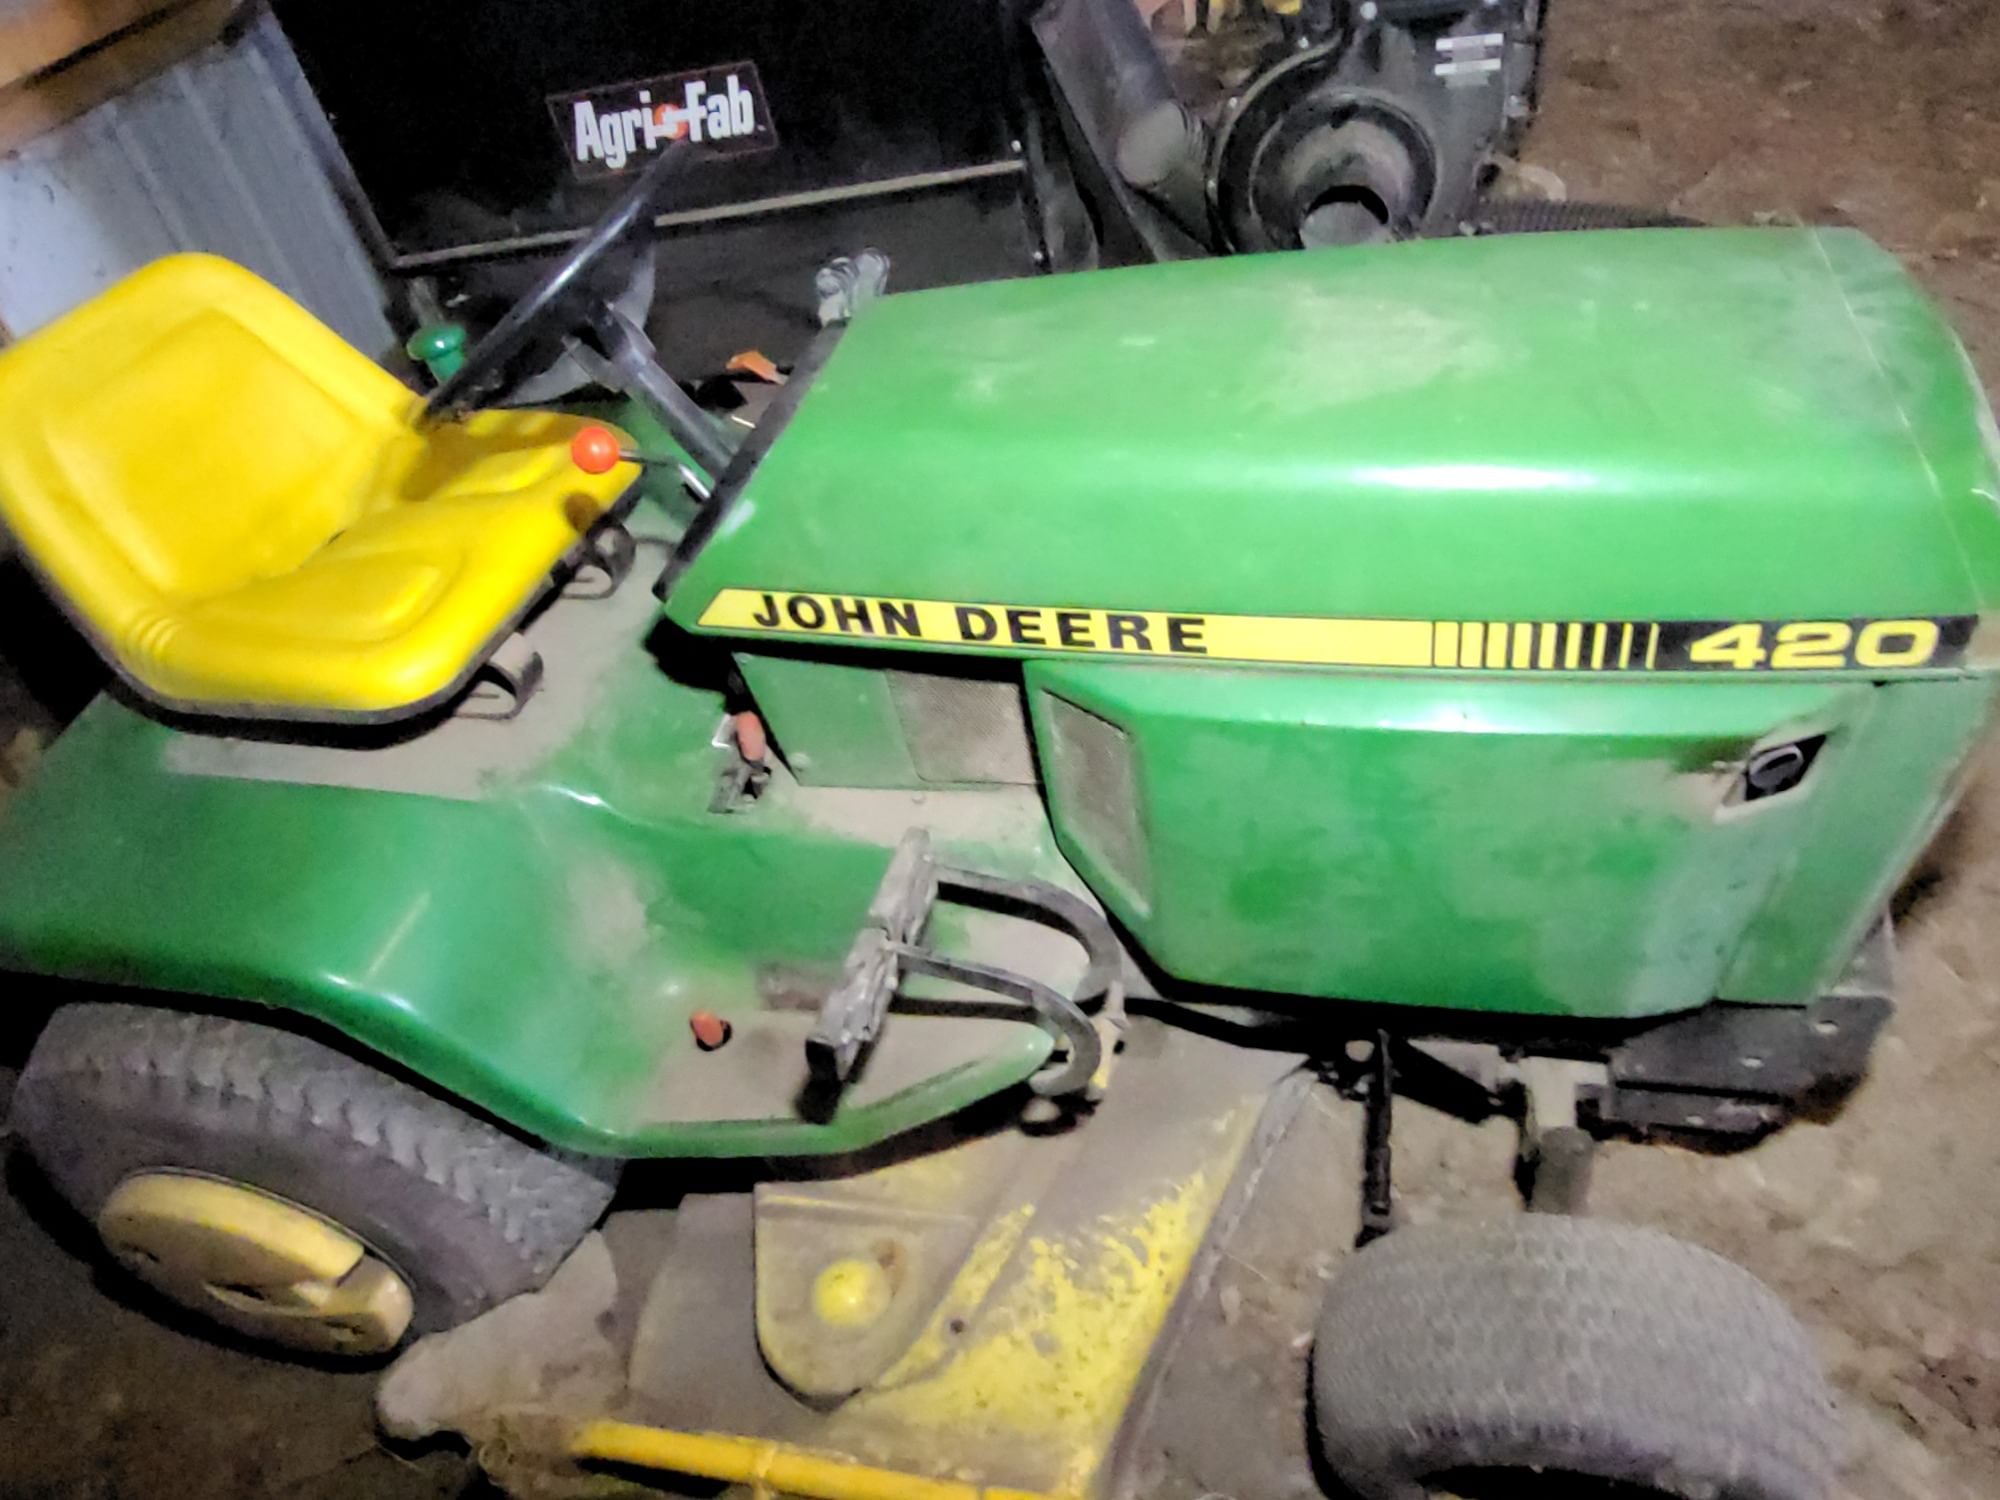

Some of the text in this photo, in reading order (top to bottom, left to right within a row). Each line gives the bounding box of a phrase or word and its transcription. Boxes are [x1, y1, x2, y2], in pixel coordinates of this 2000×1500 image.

[753, 593, 1939, 669] JOHN DEERE 420
